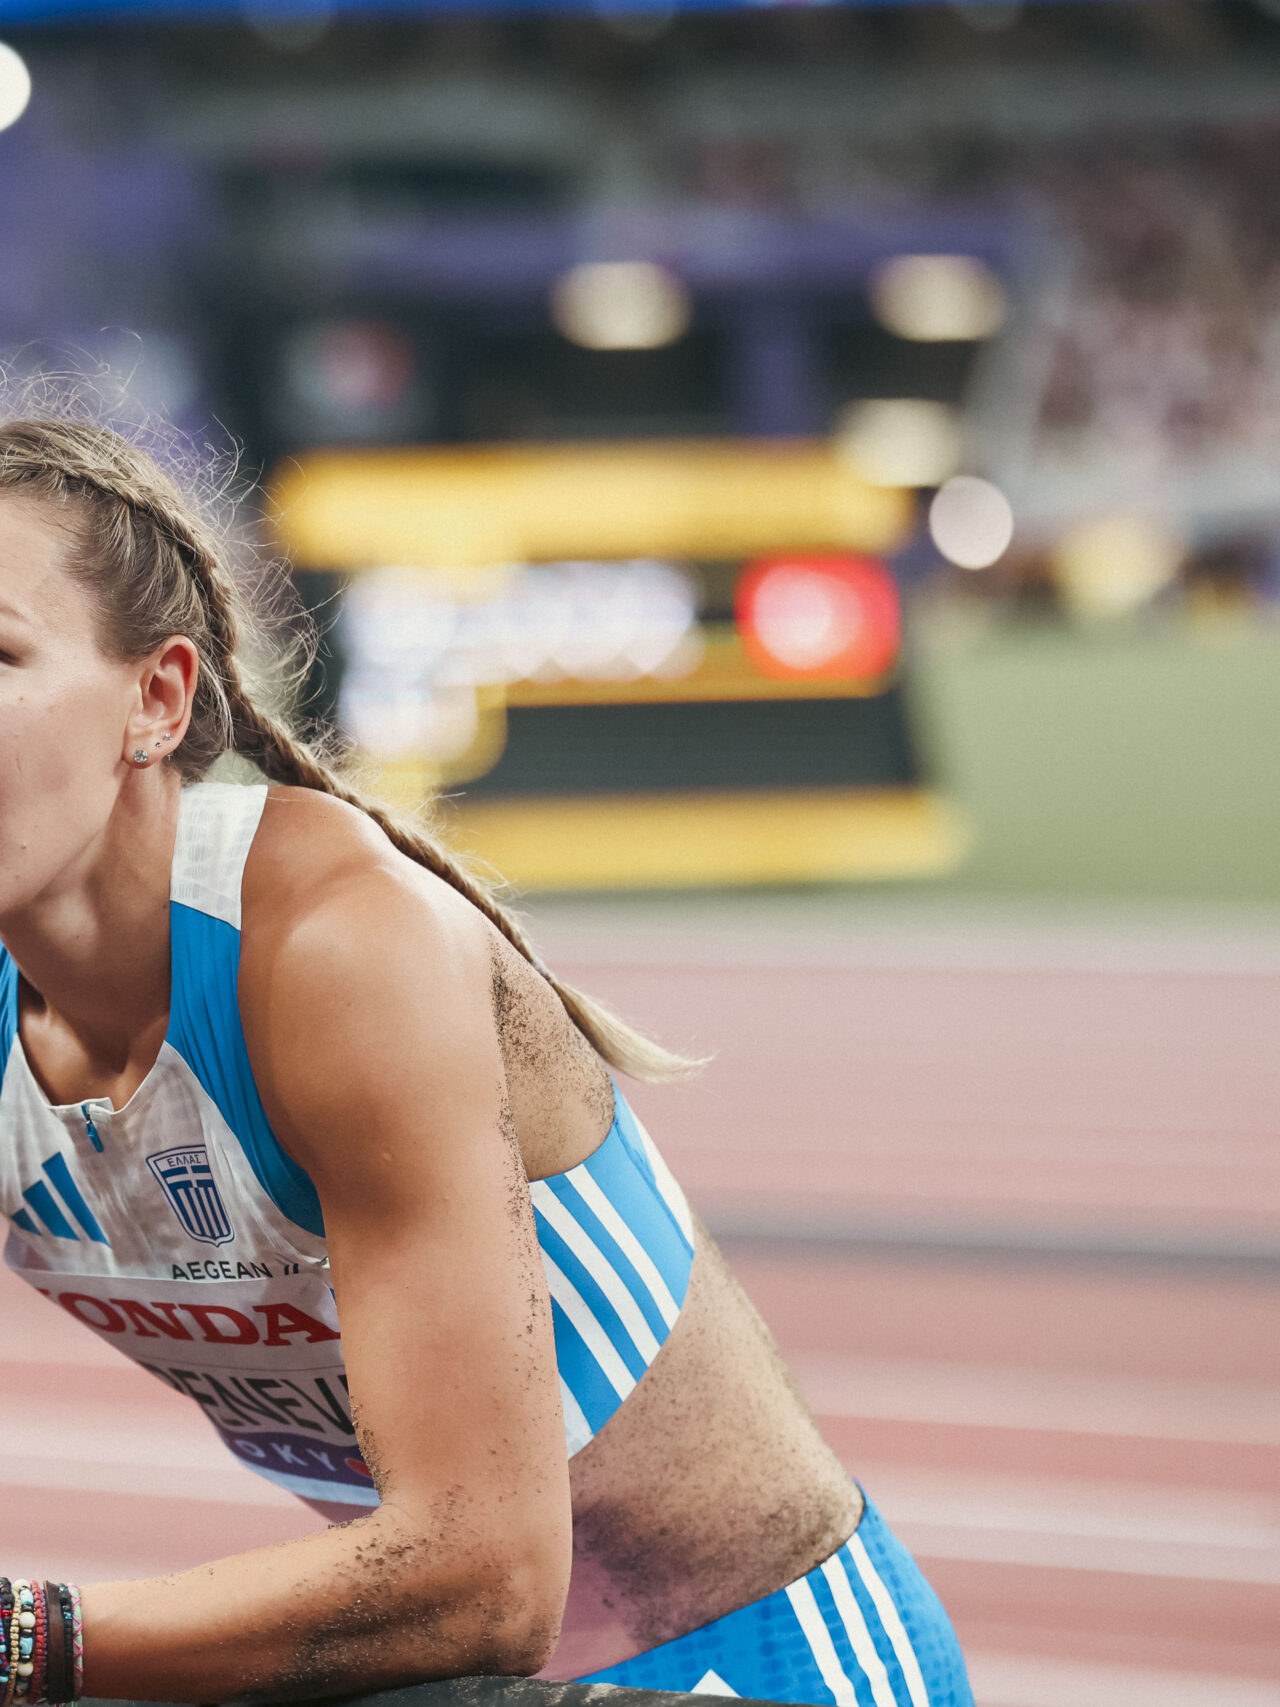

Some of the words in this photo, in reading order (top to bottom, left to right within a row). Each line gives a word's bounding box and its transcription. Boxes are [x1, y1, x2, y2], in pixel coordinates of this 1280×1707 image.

[166, 1154, 202, 1168] ΕΛΛΑΣ
[172, 1260, 274, 1281] AEGEAN
[36, 1287, 341, 1347] ONDA
[138, 1360, 355, 1436] ENEV
